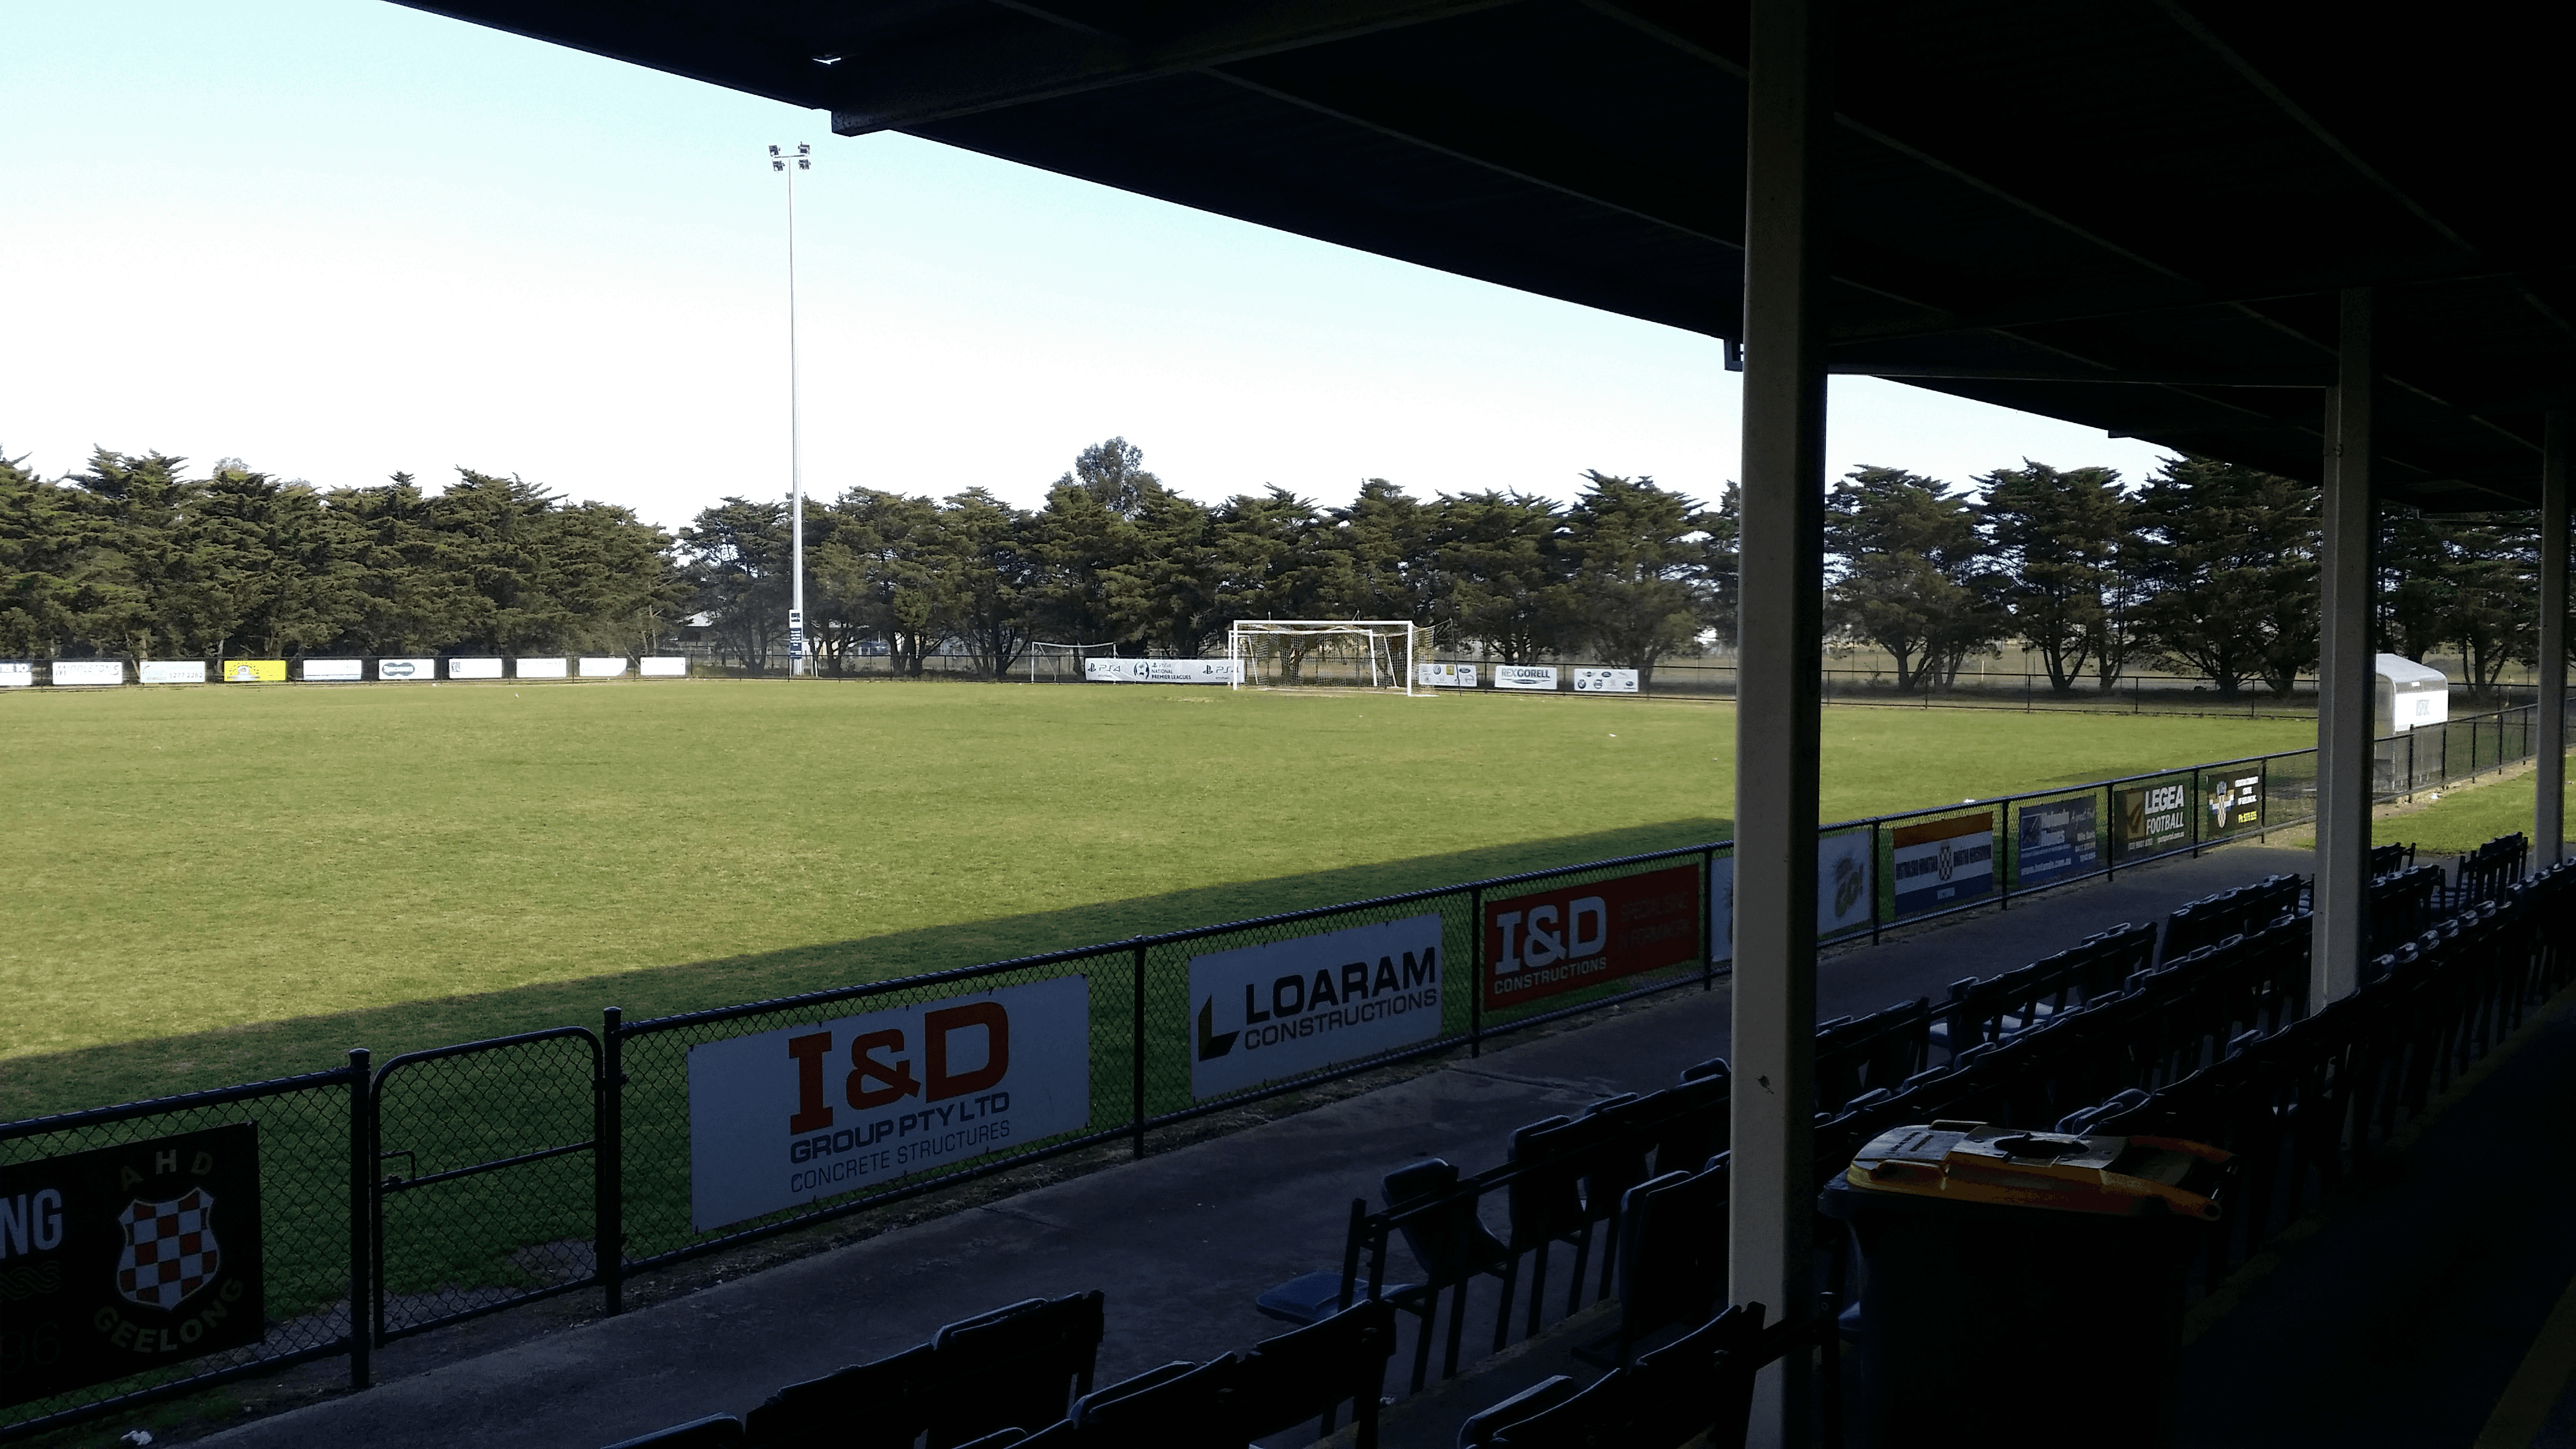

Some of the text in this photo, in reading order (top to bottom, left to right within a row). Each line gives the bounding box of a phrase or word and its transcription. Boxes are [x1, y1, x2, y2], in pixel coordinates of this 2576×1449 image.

[2145, 784, 2185, 815] LEGEA
[2146, 811, 2184, 836] FOOTBALL
[1495, 895, 1608, 975] I&D
[1246, 946, 1435, 1025] LOARAM
[1494, 956, 1608, 995] CONSTRUCTIONS
[1244, 988, 1437, 1050] CONSTRUCTIONS
[789, 1002, 1009, 1136] I&D
[790, 1092, 1010, 1164] GROUP PTY LTD
[791, 1120, 1010, 1193] CONCRETE STRUCTURES
[93, 1277, 244, 1354] GEELONG
